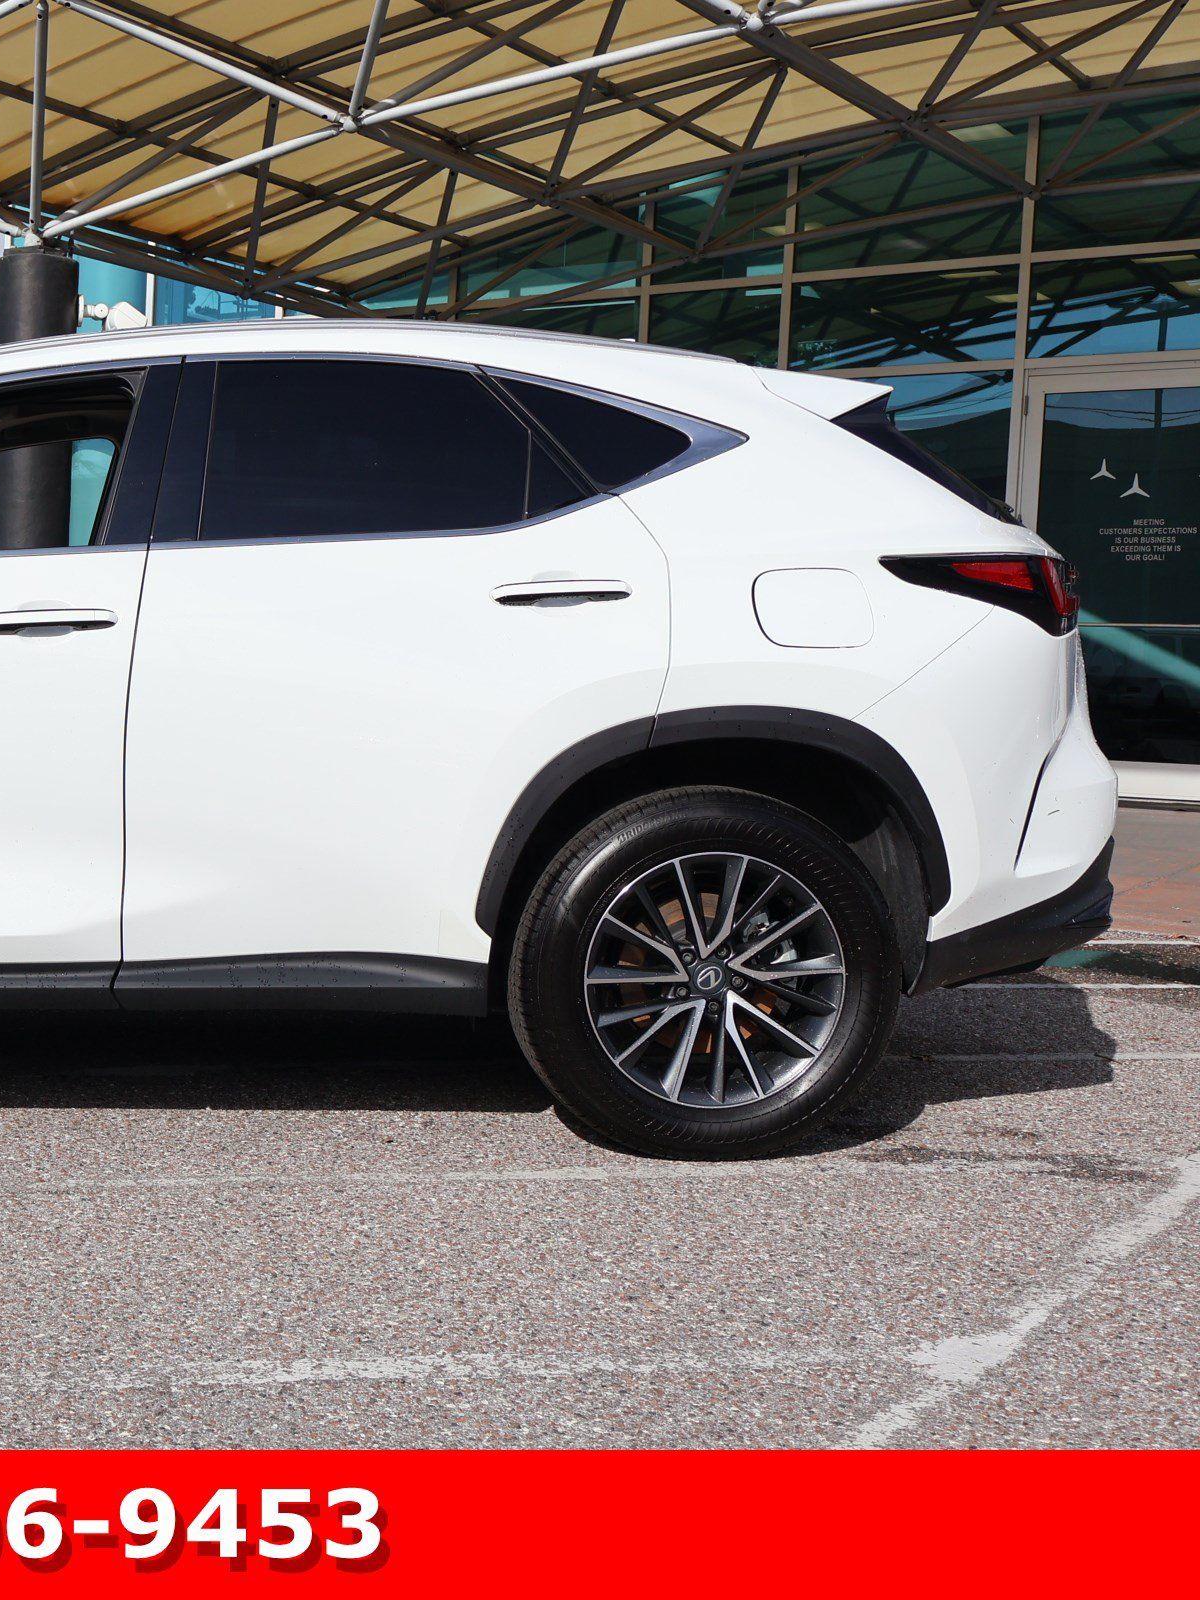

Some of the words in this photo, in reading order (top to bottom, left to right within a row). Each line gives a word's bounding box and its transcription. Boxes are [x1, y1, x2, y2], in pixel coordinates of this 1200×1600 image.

[1133, 518, 1165, 526] MEETING
[1144, 527, 1198, 535] EXPECTATIONS
[1110, 545, 1151, 553] EXCEEDING
